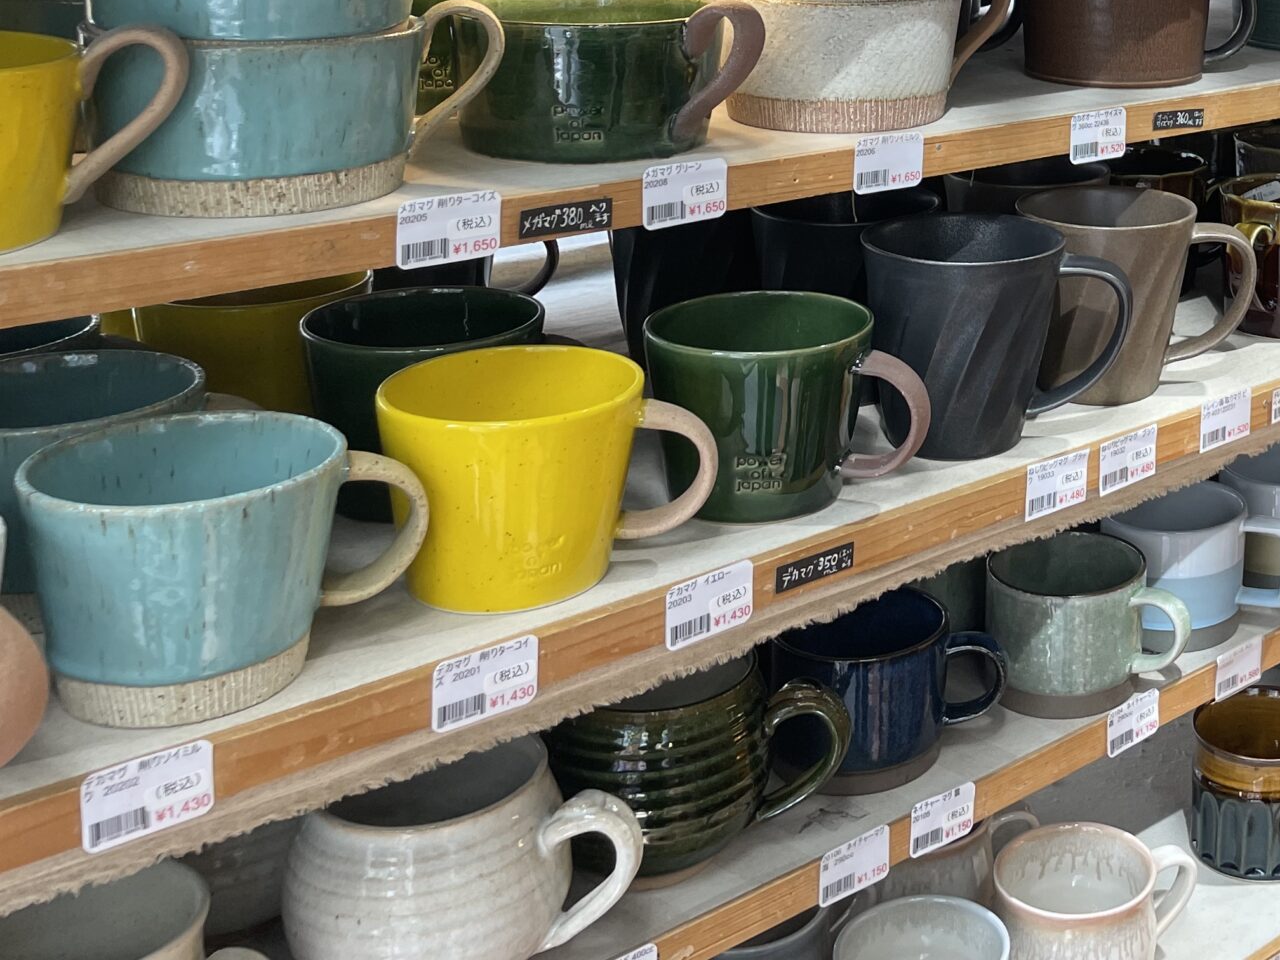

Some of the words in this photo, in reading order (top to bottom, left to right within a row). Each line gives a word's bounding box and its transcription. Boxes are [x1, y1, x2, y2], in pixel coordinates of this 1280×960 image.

[555, 128, 603, 143] japan
[856, 137, 880, 147] メガマグ
[856, 147, 876, 157] 20206
[1100, 142, 1125, 155] ¥1,520
[644, 165, 675, 179] メガマグ
[676, 163, 702, 175] グリーン
[890, 170, 921, 184] ¥1,650
[644, 178, 668, 189] 20208
[690, 182, 721, 197] (税込)
[399, 199, 434, 215] メガマグ
[689, 200, 726, 216] ¥1,650
[399, 213, 428, 225] 20205
[456, 216, 493, 232] (税込)
[523, 208, 561, 235] メガマグ
[453, 237, 498, 255] ¥1,650
[1228, 422, 1249, 438] ¥1,520
[736, 455, 785, 468] power
[751, 468, 766, 479] of
[1037, 470, 1055, 481] 19033
[1130, 461, 1154, 479] ¥1,480
[736, 480, 782, 493] japan
[1058, 489, 1085, 504] ¥1,480
[781, 557, 818, 589] デカマグ
[817, 552, 839, 572] 350
[668, 579, 698, 598] デカマグ
[703, 570, 732, 586] イエロー
[667, 593, 693, 609] 20203
[716, 585, 748, 608] (税込)
[713, 604, 752, 627] ¥1,430
[436, 657, 473, 676] デカマグ
[453, 664, 481, 683] 20201
[492, 662, 530, 685] (税込)
[490, 684, 536, 709] ¥1,430
[1135, 720, 1158, 738] ¥1,150
[84, 767, 128, 790] デカマグ
[155, 771, 202, 798] (税込)
[103, 777, 141, 797] 20202
[155, 792, 212, 822] ¥1,430
[945, 819, 972, 839] ¥1,150
[857, 863, 887, 885] ¥1,150
